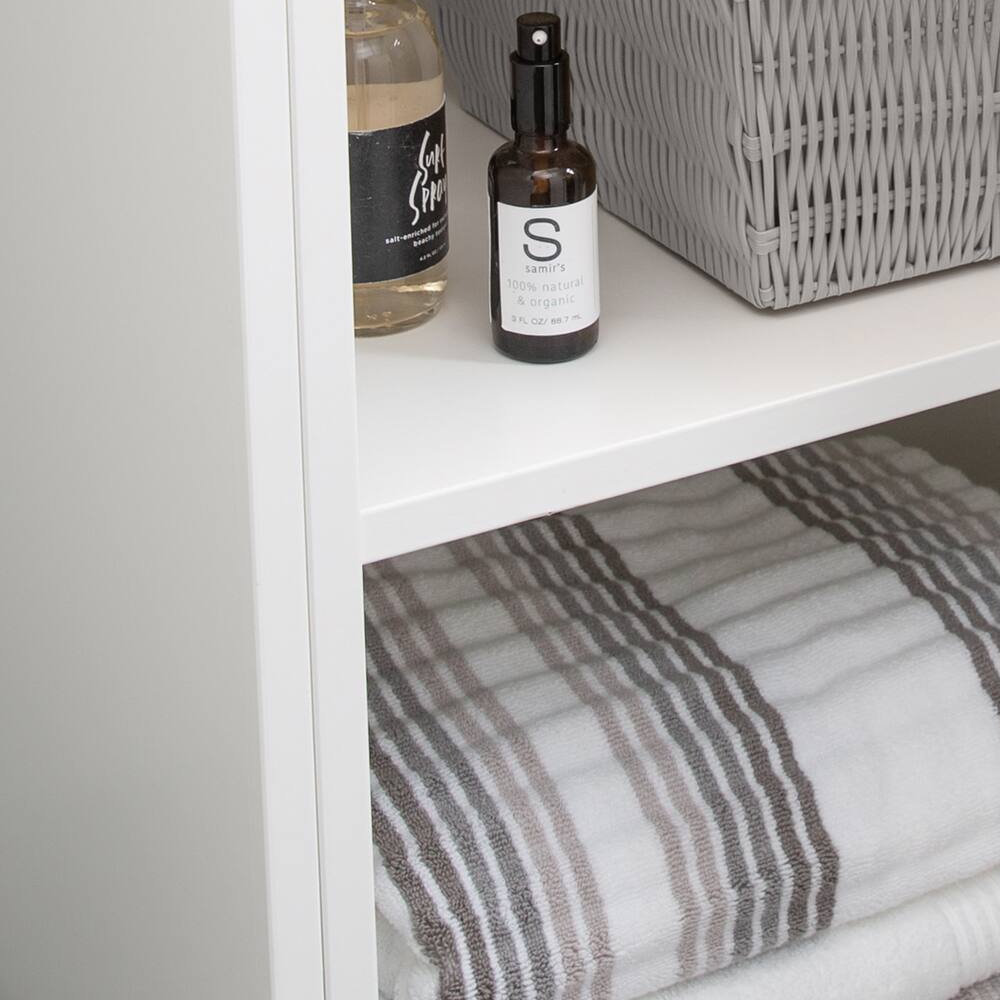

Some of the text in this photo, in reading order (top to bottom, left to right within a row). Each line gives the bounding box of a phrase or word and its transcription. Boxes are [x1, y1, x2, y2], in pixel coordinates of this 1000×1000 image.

[385, 224, 432, 245] salt-enriched
[523, 217, 562, 262] S
[524, 262, 566, 274] samir's
[506, 275, 584, 293] 100% natural
[517, 293, 576, 310] & organic
